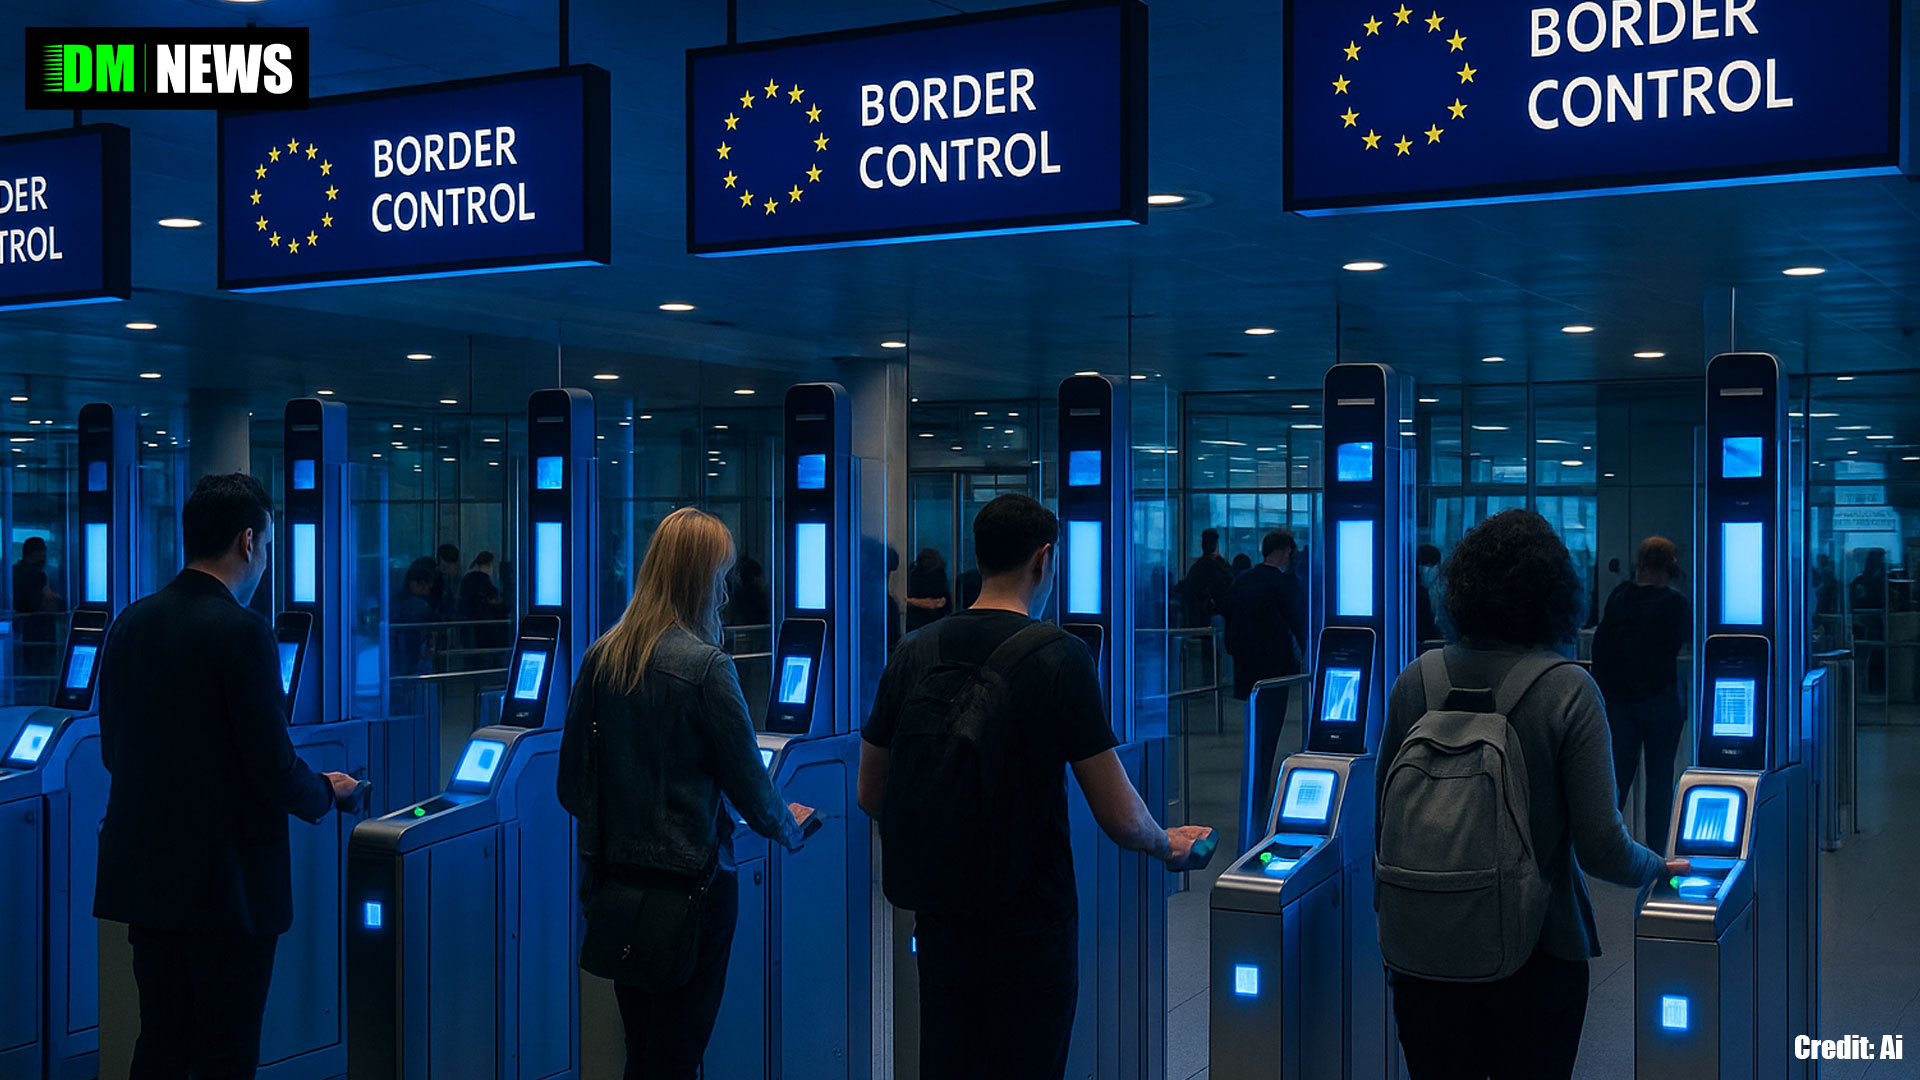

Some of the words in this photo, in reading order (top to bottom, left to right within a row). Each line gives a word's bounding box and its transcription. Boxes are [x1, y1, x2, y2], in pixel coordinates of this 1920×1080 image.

[1530, 0, 1760, 58] BORDER
[860, 68, 1038, 128] BORDER
[1526, 58, 1795, 130] CONTROL
[372, 126, 519, 179] BORDER
[858, 129, 1061, 190] CONTROL
[371, 181, 537, 234] CONTROL
